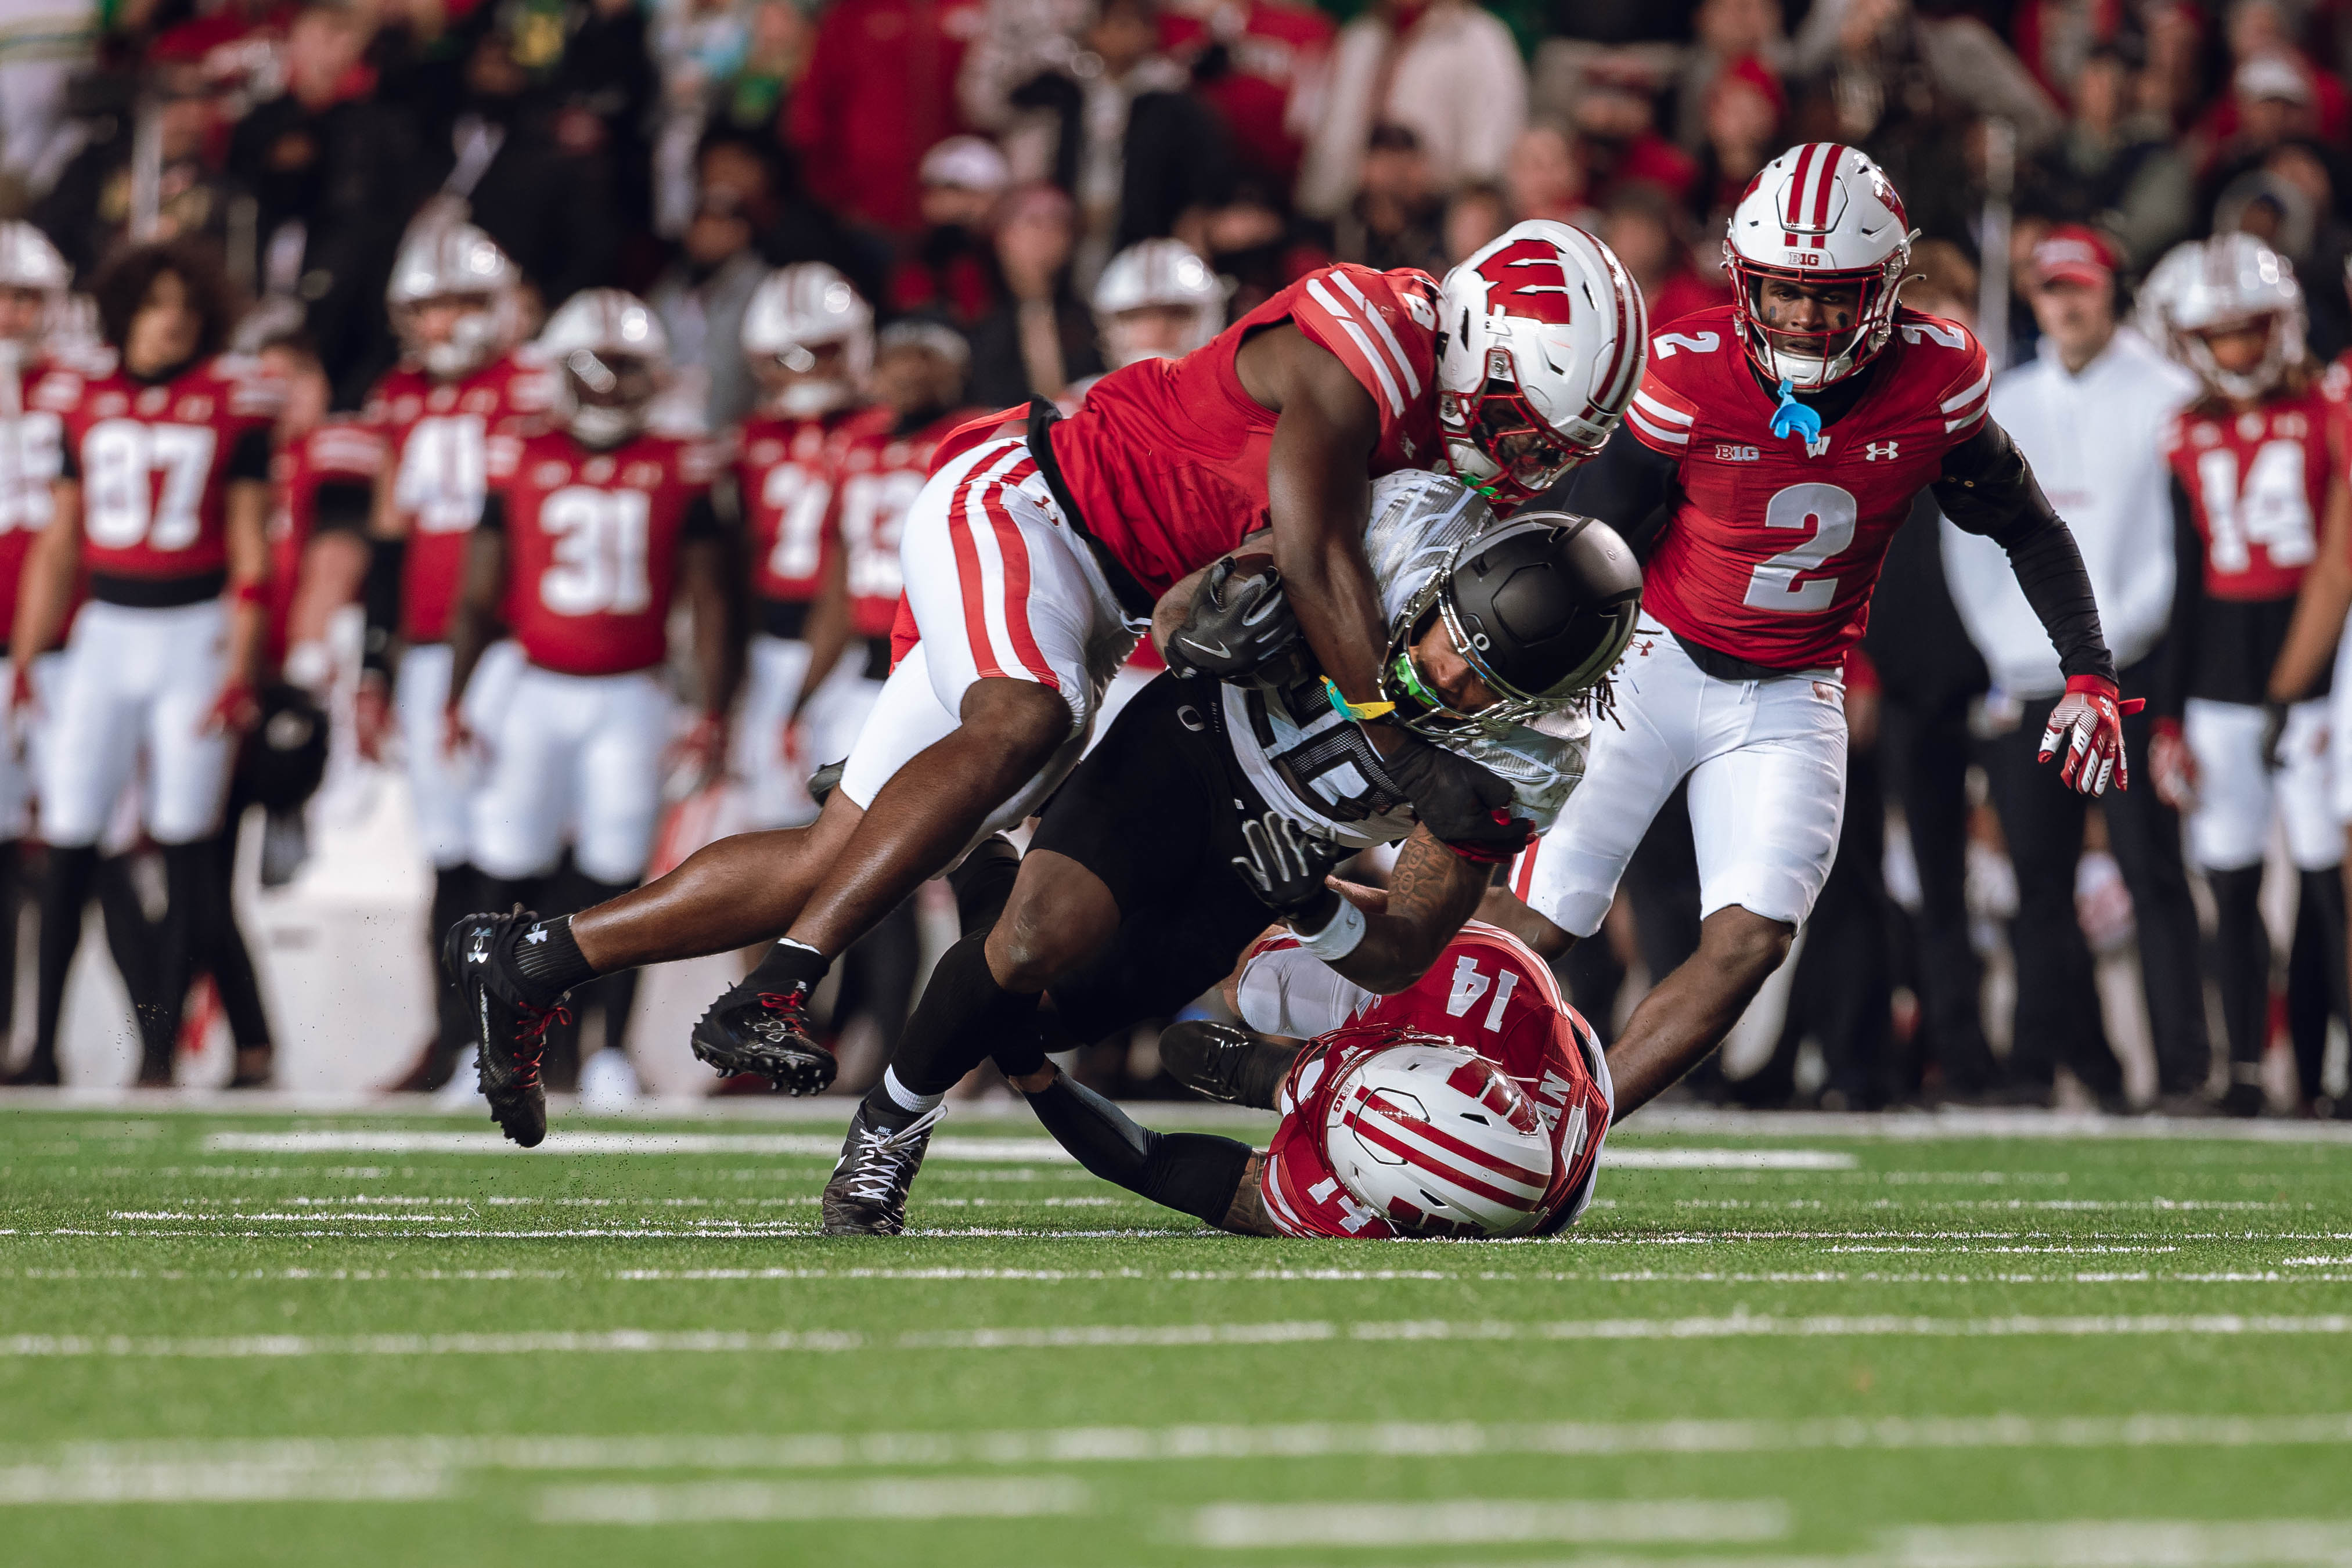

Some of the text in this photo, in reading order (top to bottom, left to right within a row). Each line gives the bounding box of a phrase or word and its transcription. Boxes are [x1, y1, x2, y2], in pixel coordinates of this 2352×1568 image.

[1652, 331, 1720, 360] 2
[1901, 323, 1966, 351] 2
[80, 418, 220, 549] 87
[762, 461, 833, 580] 7
[2197, 439, 2318, 575] 14
[539, 485, 652, 617] 31
[1743, 482, 1857, 611] 2
[1446, 955, 1519, 1033] 14
[877, 1126, 892, 1134] NIKE
